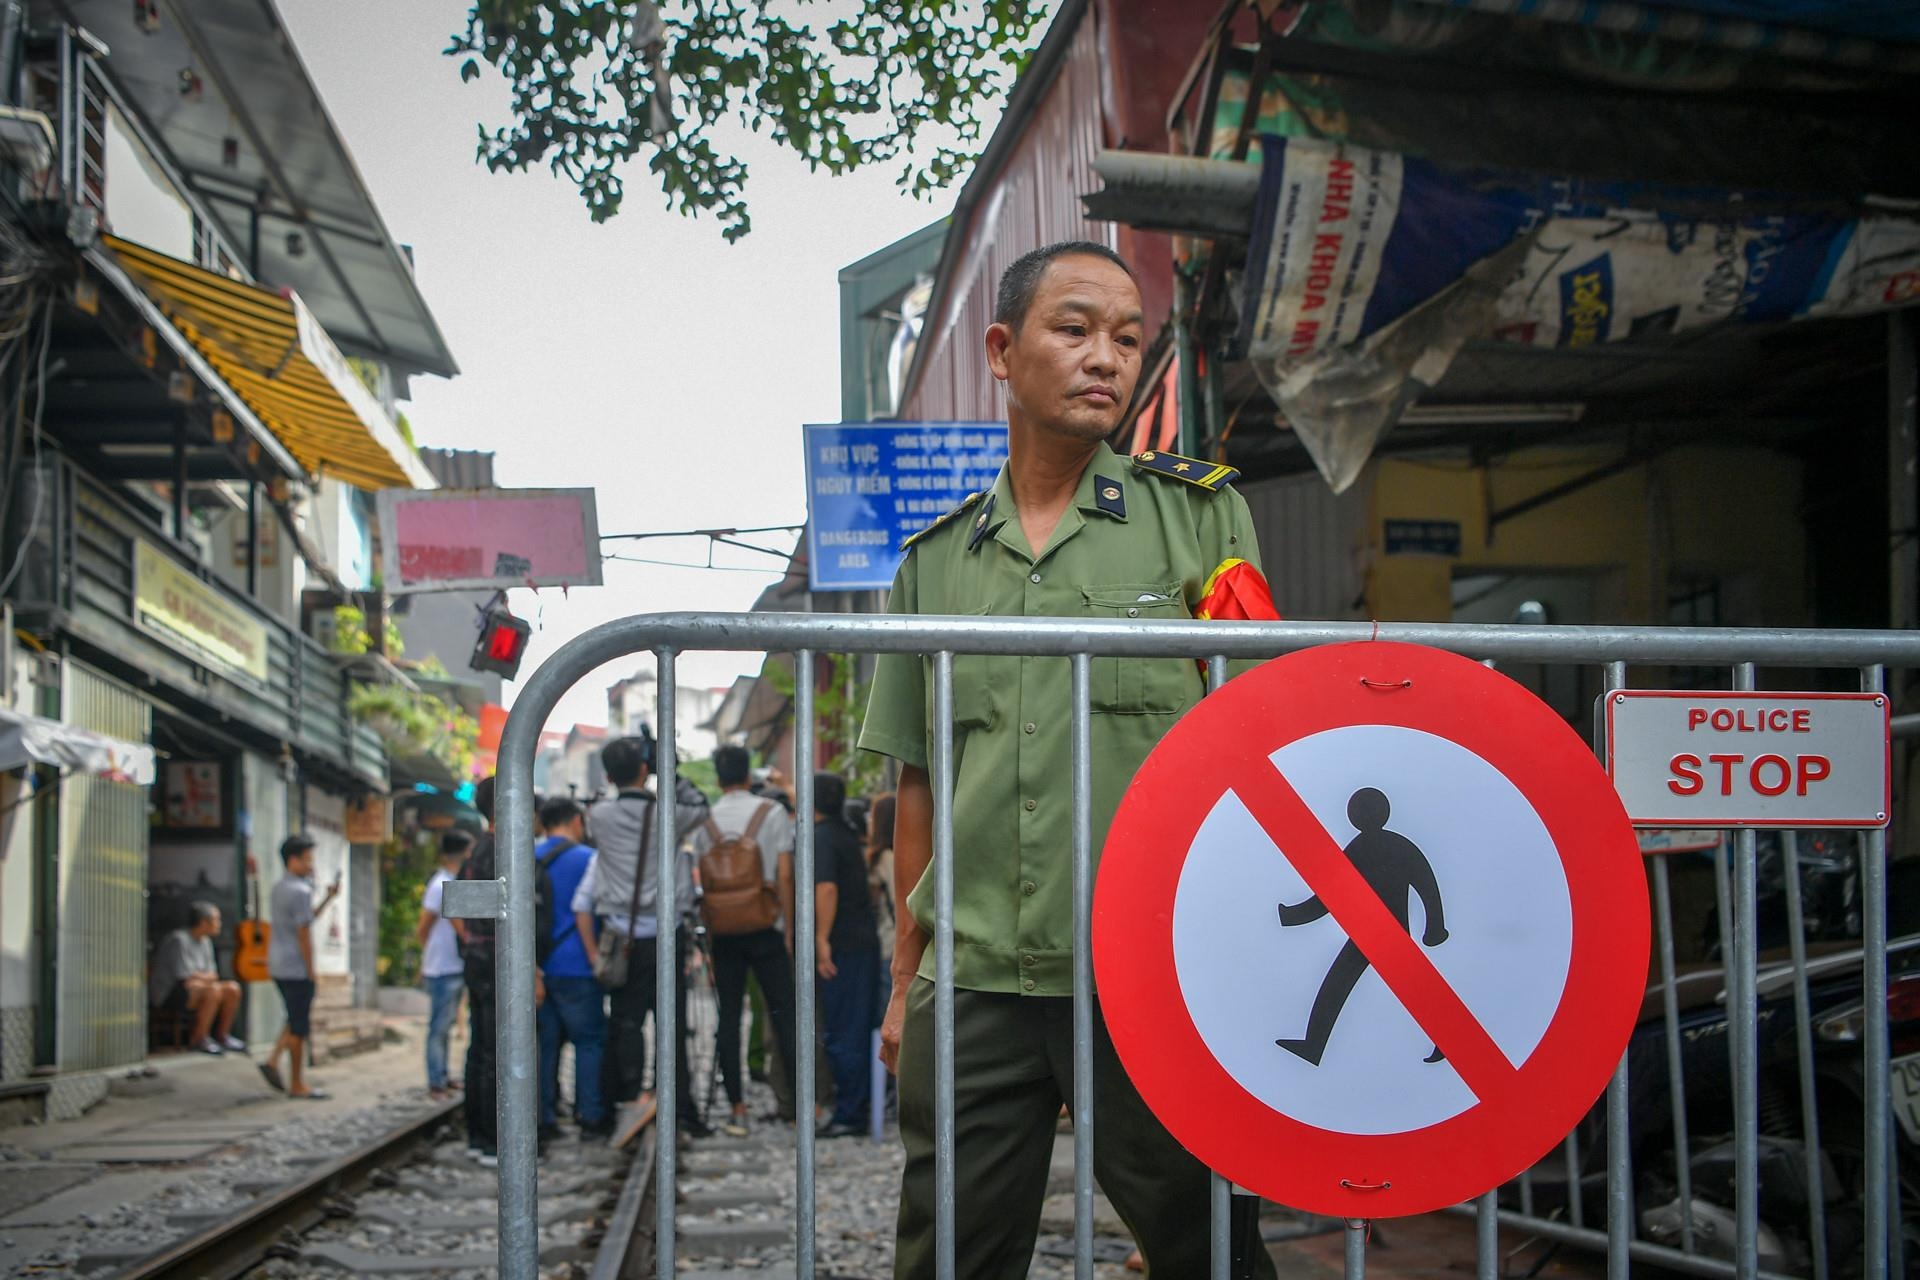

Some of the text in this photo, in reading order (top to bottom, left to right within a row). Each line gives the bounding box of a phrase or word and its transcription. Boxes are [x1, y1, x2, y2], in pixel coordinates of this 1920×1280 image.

[1319, 159, 1355, 223] NHA
[1301, 233, 1344, 312] KHOA
[820, 530, 889, 546] DANGEROUS
[838, 553, 870, 568] AREA
[1688, 708, 1811, 733] POLICE
[1667, 753, 1831, 796] STOP
